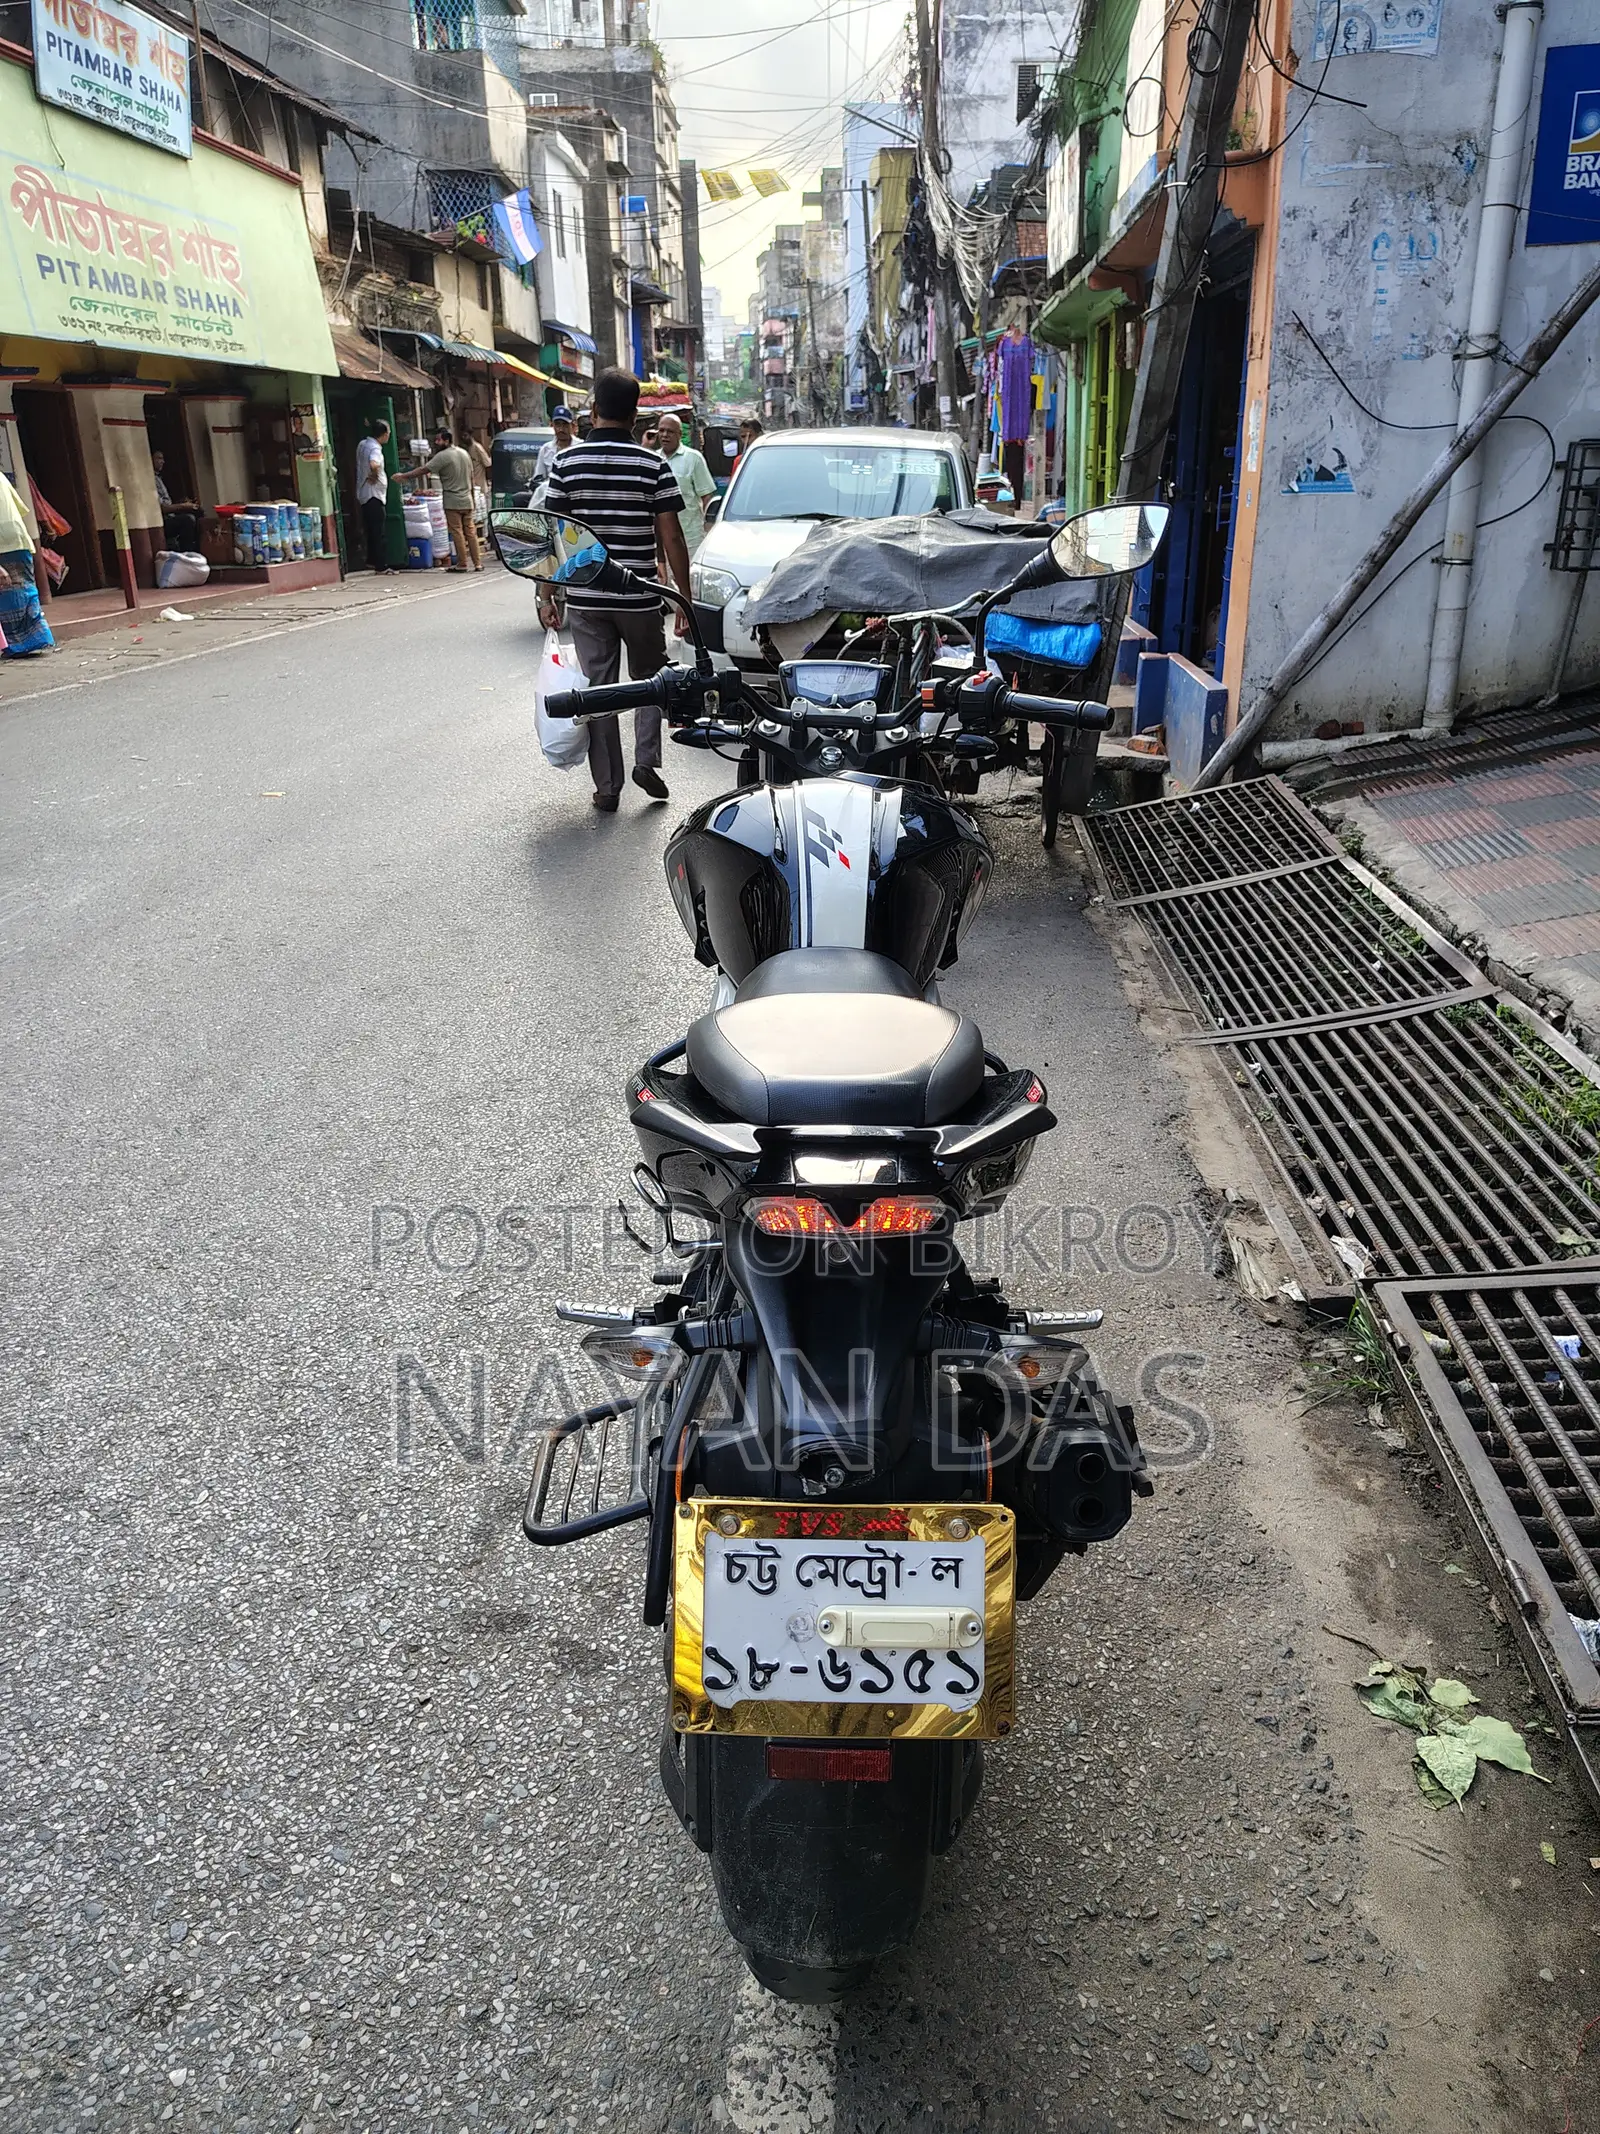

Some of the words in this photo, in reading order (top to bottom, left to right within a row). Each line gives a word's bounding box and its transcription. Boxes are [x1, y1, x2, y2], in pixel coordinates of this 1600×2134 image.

[46, 30, 133, 89] PITAMBAR
[139, 74, 182, 114] SHAHA
[70, 74, 133, 110] জেনারেল
[11, 165, 177, 279] পীতাম্বর
[177, 219, 249, 307] শাহ
[36, 254, 169, 305] PITAMBAR
[174, 286, 243, 319] SHAHA
[70, 296, 159, 324] জেনারেল
[170, 312, 234, 336] মার্চেন্ট
[896, 463, 936, 474] PRESS
[774, 1511, 844, 1536] TVS
[724, 1541, 782, 1596] চট্ট
[704, 1646, 980, 1695] ১৮-৬১৫১
